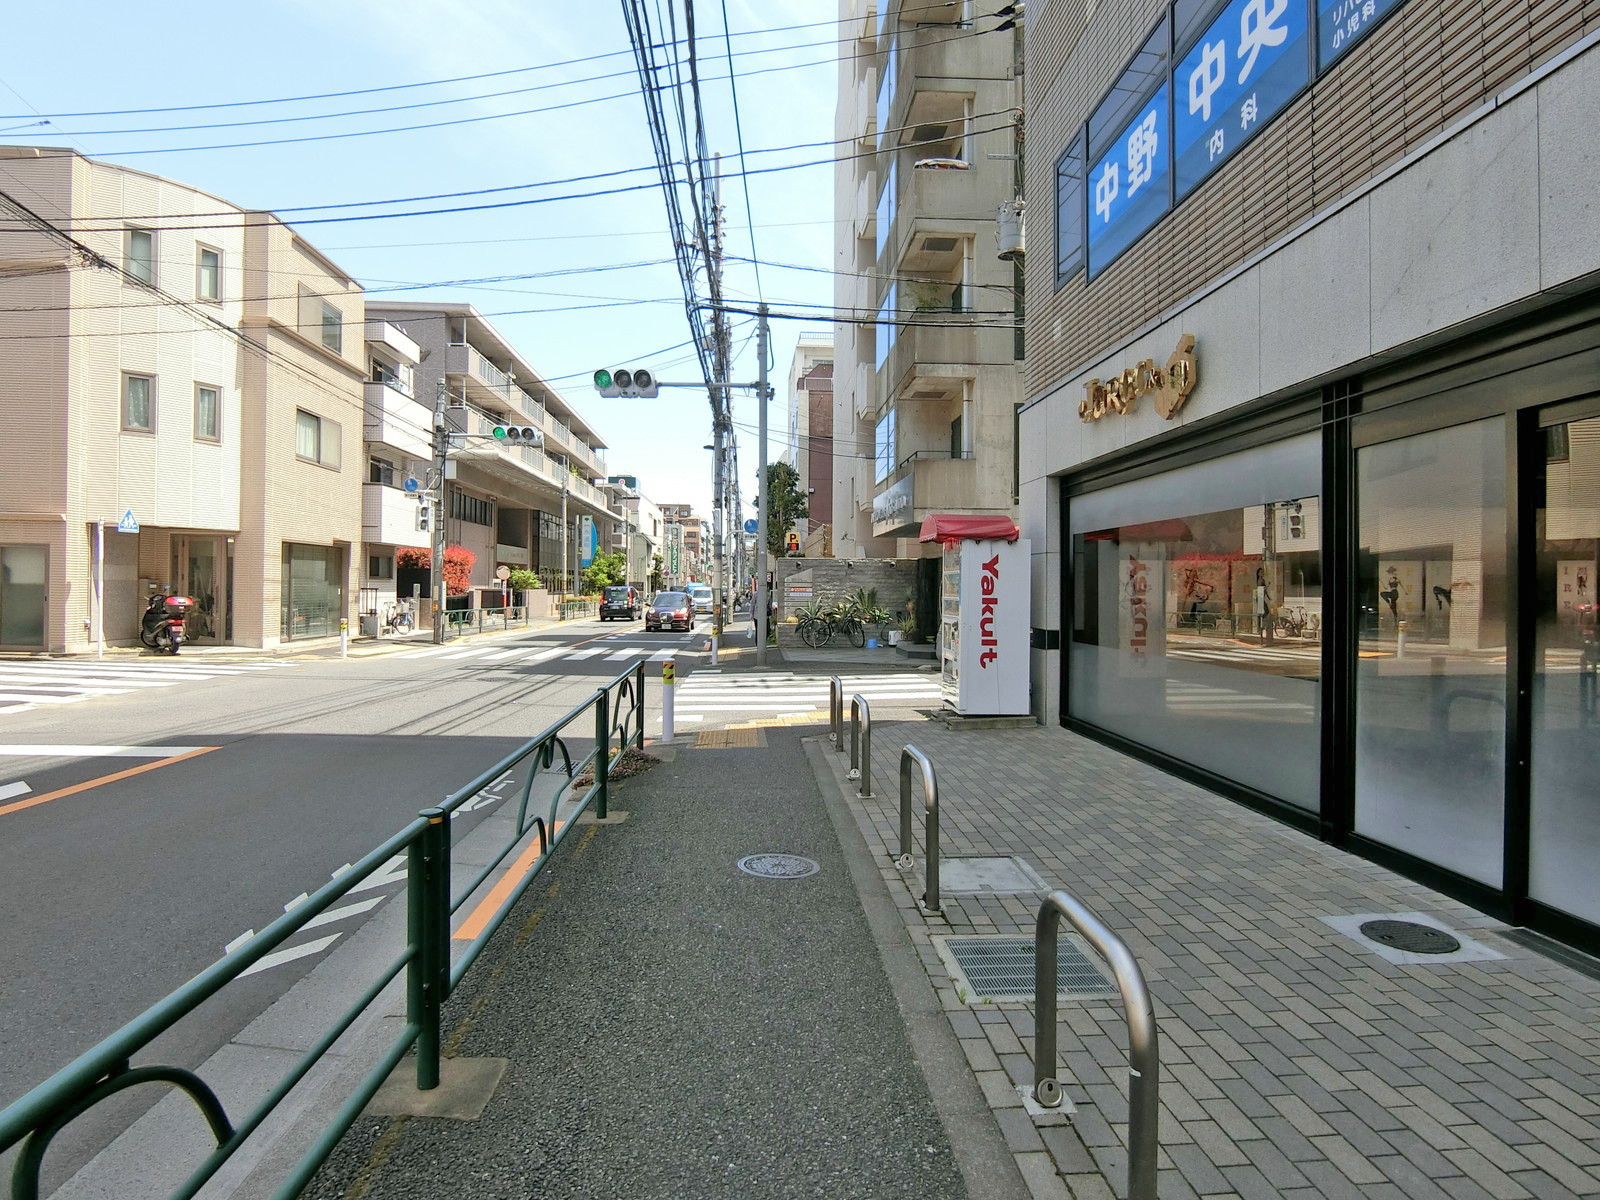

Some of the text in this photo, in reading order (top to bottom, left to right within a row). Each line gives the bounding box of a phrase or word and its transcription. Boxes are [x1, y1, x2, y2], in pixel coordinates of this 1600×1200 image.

[1333, 0, 1376, 49] 小児科
[1210, 93, 1258, 162] 内科
[979, 554, 999, 669] Yakult
